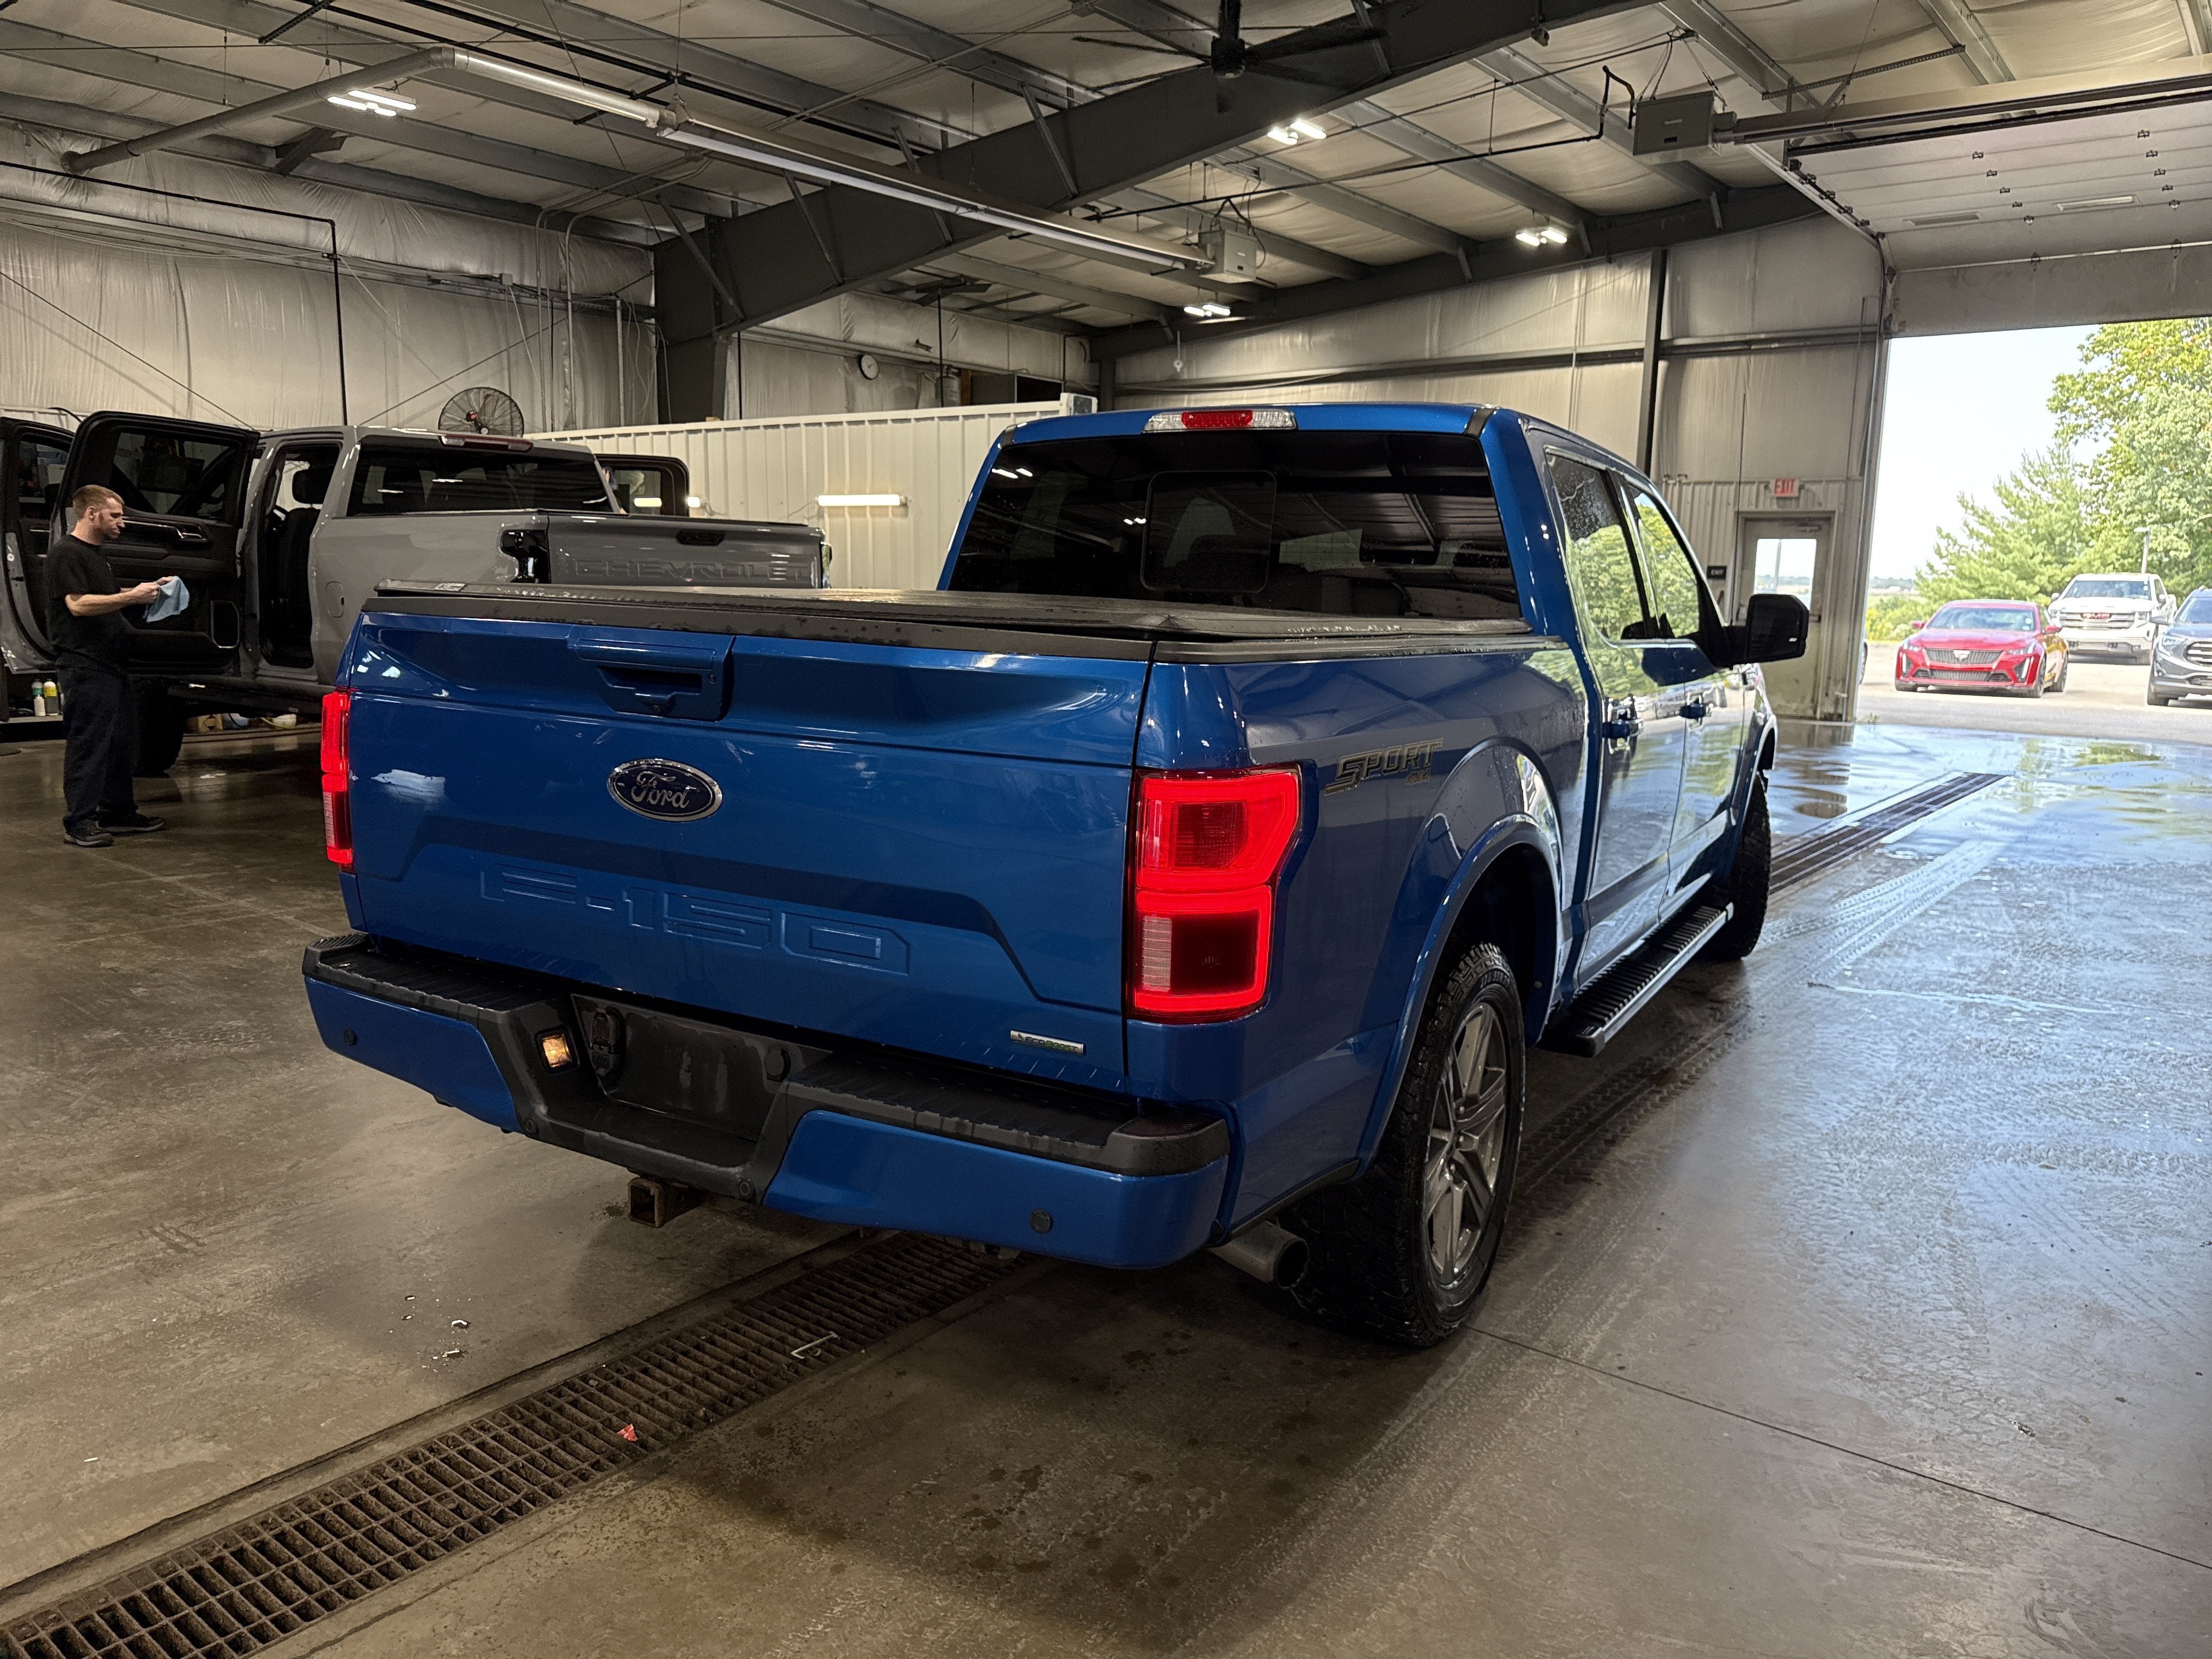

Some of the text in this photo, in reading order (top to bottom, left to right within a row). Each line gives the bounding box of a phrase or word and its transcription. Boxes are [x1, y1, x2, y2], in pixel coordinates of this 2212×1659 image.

[1774, 478, 1796, 495] EXIT
[575, 559, 810, 582] CHEVROLET
[1324, 737, 1443, 797] SPORT
[631, 771, 690, 809] Ford
[480, 863, 911, 975] F-150
